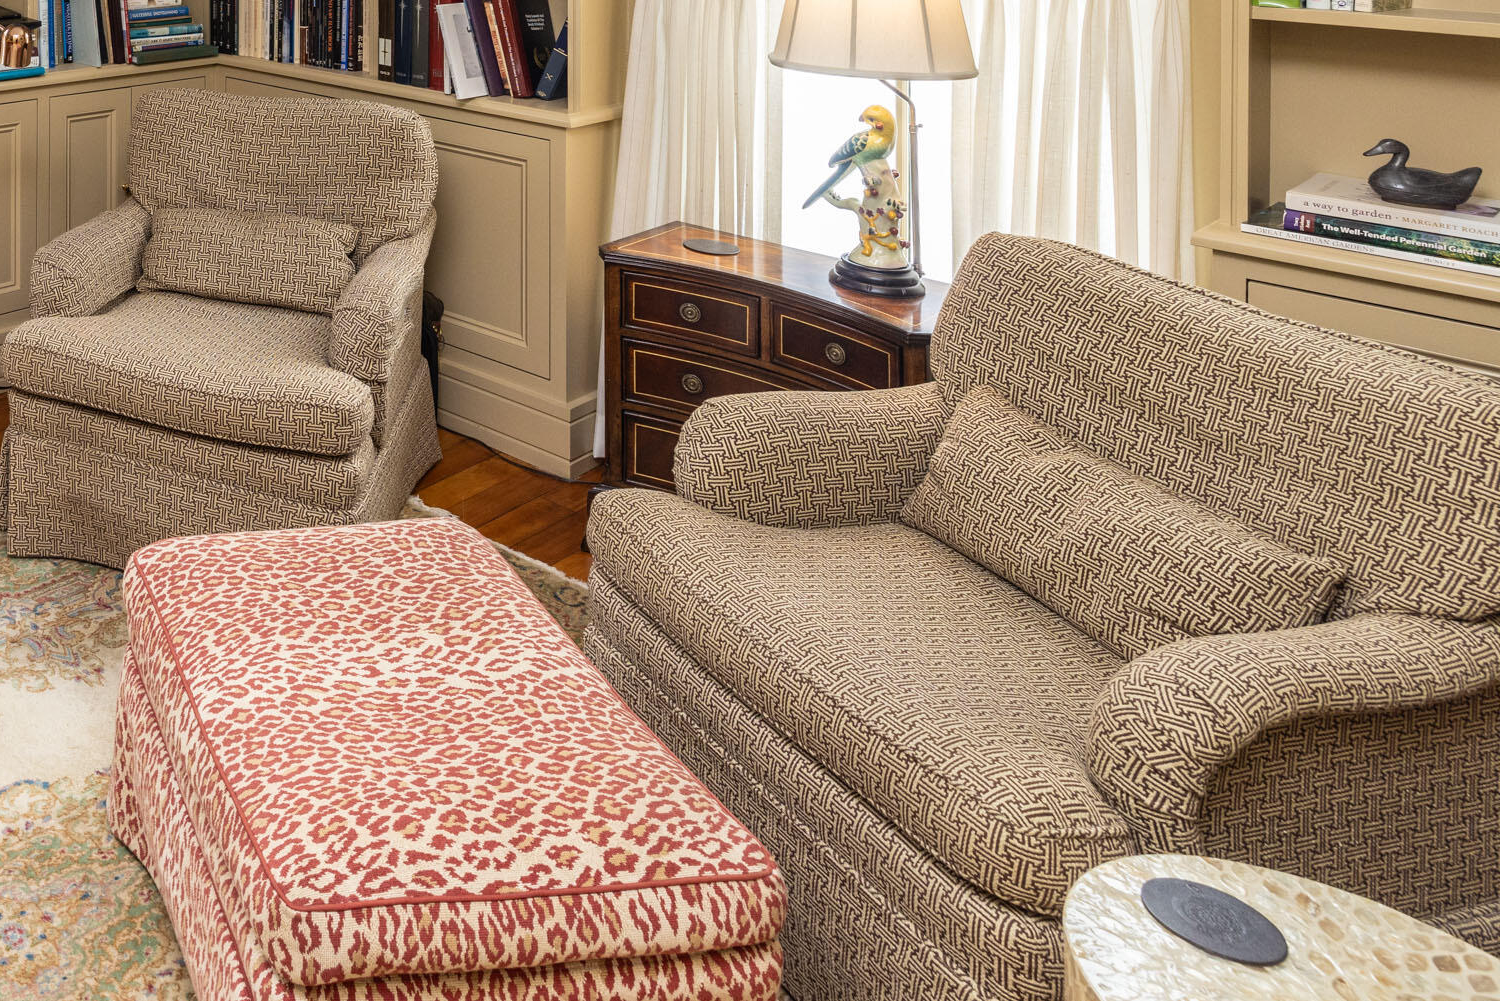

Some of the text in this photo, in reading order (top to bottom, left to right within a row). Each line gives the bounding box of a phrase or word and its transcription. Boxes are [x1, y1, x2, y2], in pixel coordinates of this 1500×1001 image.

[1313, 202, 1334, 213] way
[1337, 204, 1349, 214] to
[1351, 206, 1392, 221] garden
[1402, 217, 1458, 231] MARGARET
[1462, 225, 1499, 238] ROACH
[1256, 227, 1375, 254] GREAT AMERICAN GARDENS
[1322, 223, 1488, 258] The Well-Tended Perennial Garden
